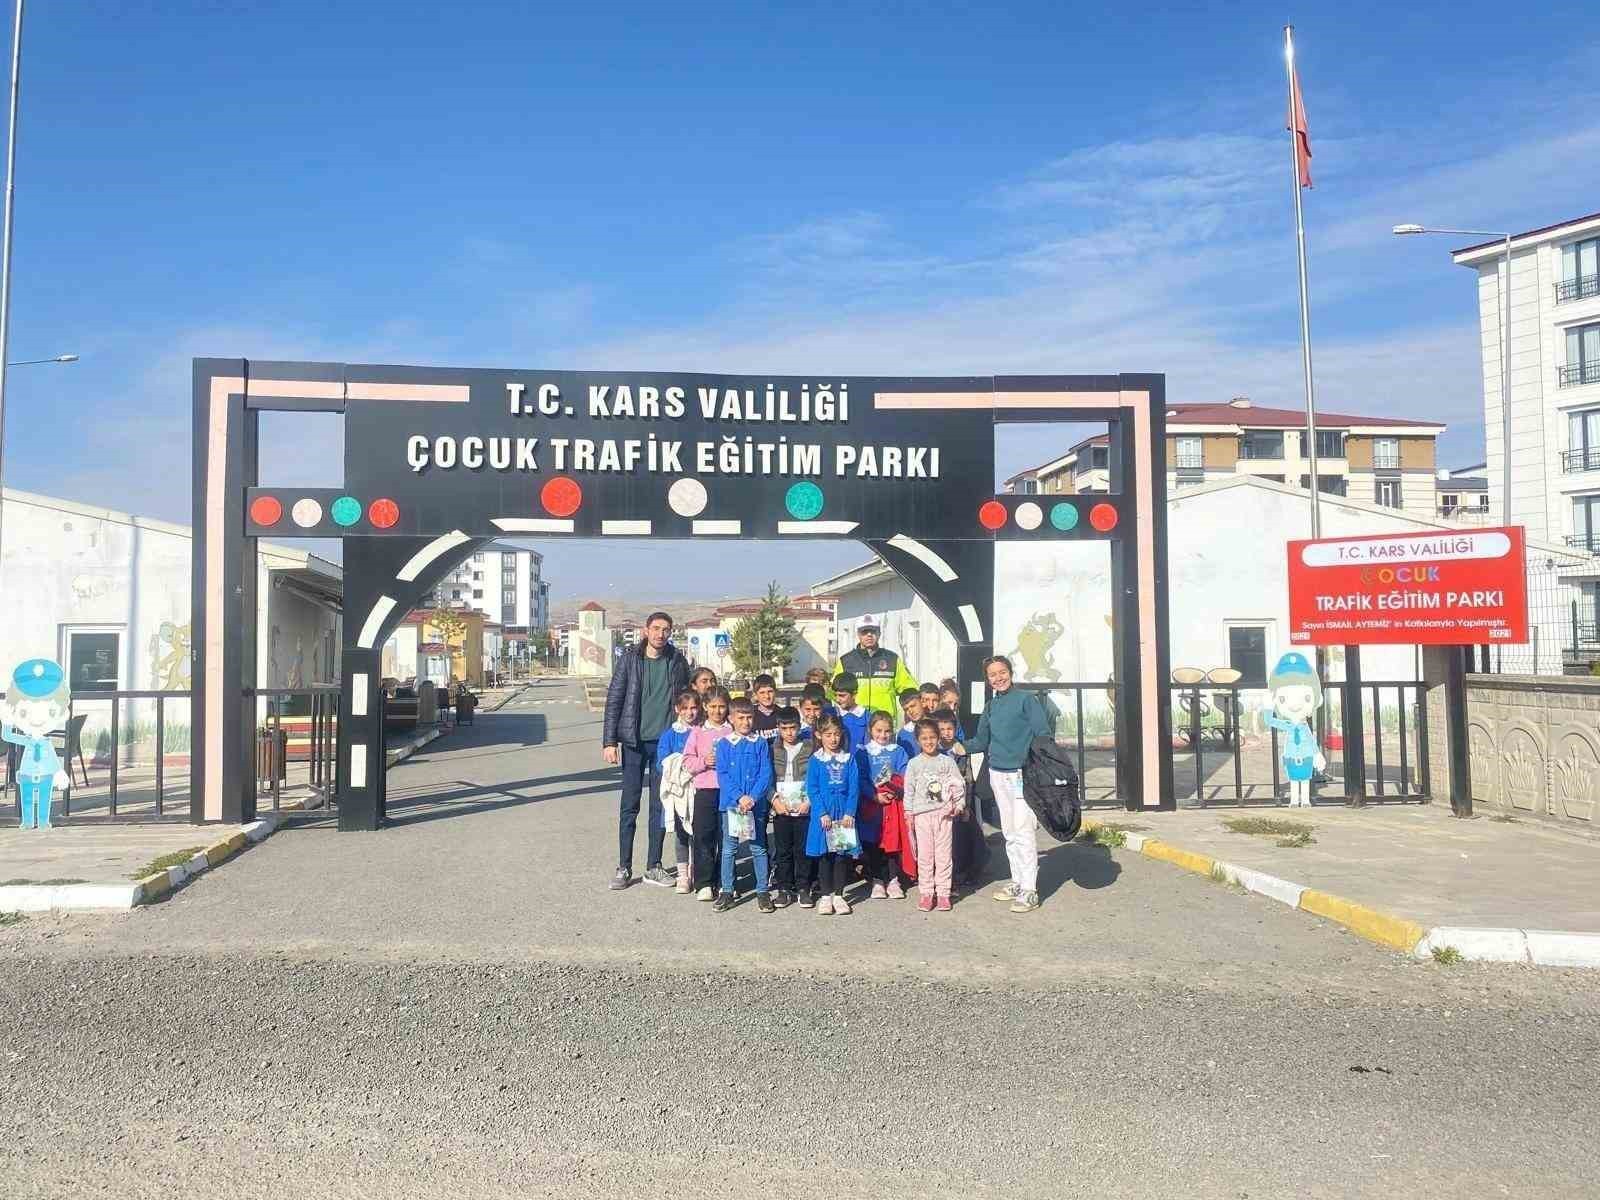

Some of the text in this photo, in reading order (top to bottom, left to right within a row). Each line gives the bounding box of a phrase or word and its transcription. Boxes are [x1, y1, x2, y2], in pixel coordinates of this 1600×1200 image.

[506, 383, 849, 421] T.C. KARS VALİLİĞİ
[406, 432, 940, 479] ÇOCUK TRAFİK EĞİTİM PARKI
[1338, 538, 1474, 560] T.C. KARS VALİLİĞİ
[1315, 590, 1504, 611] TRAFİK EĞİTİM PARKI
